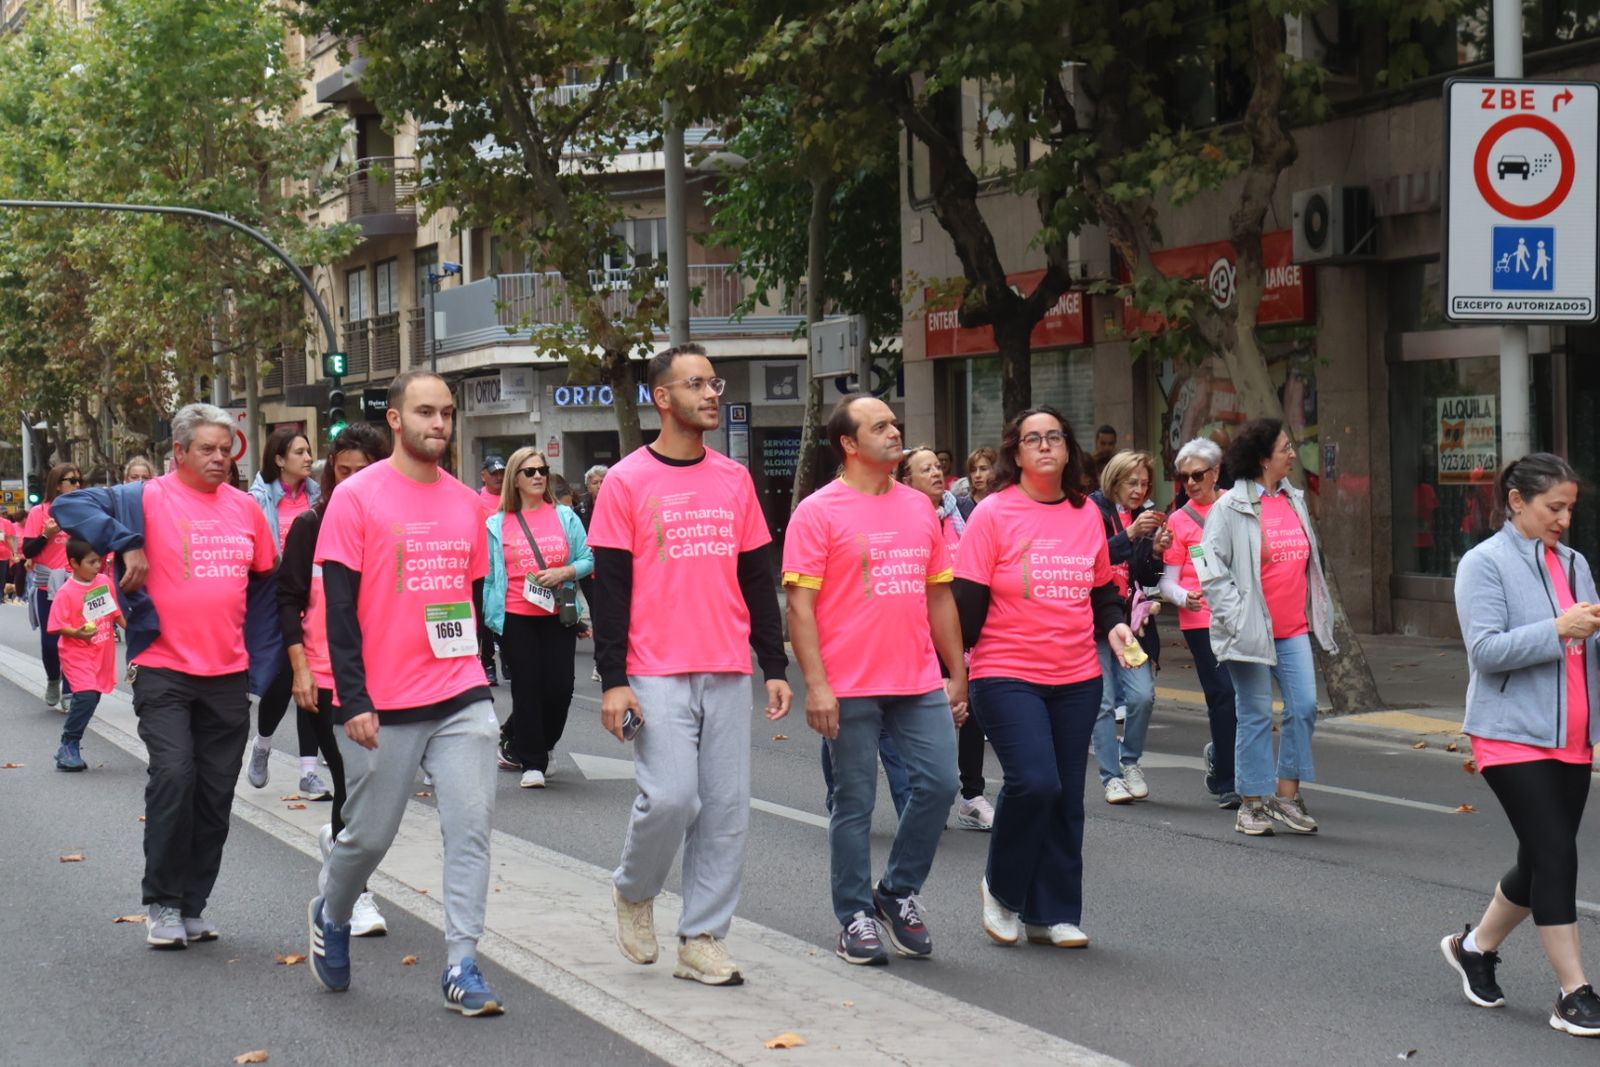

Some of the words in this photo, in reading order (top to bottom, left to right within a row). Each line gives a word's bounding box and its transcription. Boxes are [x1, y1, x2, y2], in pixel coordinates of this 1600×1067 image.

[1481, 88, 1535, 110] ZBE
[1456, 300, 1503, 310] EXCEPTO
[1506, 301, 1587, 311] AUTORIZADOS
[928, 309, 961, 332] ENTERT
[1441, 399, 1492, 419] ALQUILA
[763, 449, 800, 457] REPARAC
[764, 468, 792, 476] VENTA
[662, 510, 682, 523] En
[685, 507, 735, 521] marcha
[191, 533, 208, 545] En
[665, 523, 717, 540] contra
[719, 523, 734, 538] el
[406, 539, 423, 553] En
[669, 539, 736, 559] cáncer
[192, 547, 244, 561] contra
[520, 553, 566, 568] cácer
[870, 548, 887, 560] En
[1030, 553, 1049, 565] En
[1052, 554, 1095, 566] marcha
[1271, 549, 1310, 563] cánce
[194, 561, 248, 578] cánce
[405, 554, 457, 571] contra
[871, 561, 920, 577] contra
[407, 571, 465, 591] cánce
[1031, 567, 1083, 581] contra
[1084, 569, 1094, 582] el
[87, 596, 107, 611] 2622
[435, 621, 463, 639] 1669
